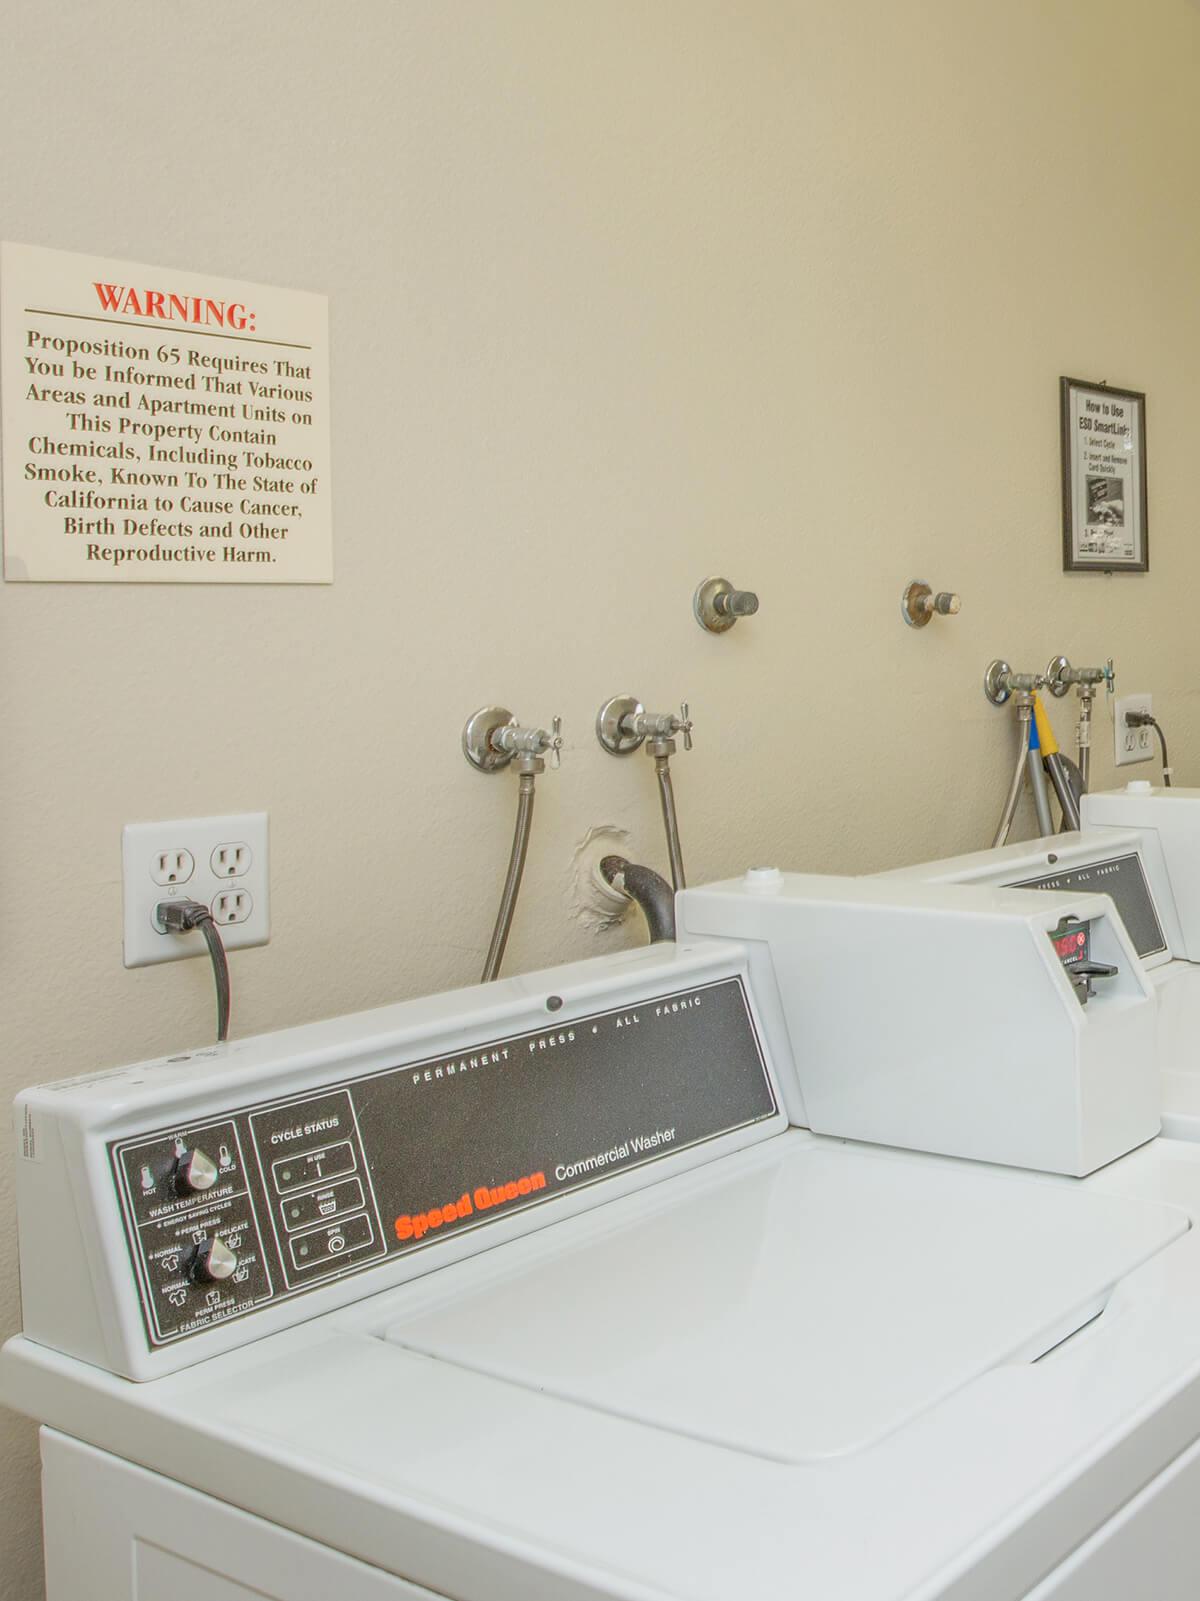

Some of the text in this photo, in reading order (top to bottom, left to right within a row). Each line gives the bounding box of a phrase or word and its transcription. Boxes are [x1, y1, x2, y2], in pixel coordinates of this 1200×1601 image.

[92, 282, 256, 331] WARNING:
[26, 330, 311, 379] Proposition 65 Requires That
[24, 357, 312, 402] You be Informed That Various
[25, 384, 312, 424] Areas and Apartment Units on
[1111, 404, 1124, 418] Use
[66, 413, 277, 445] This Property Contain
[28, 437, 312, 471] Chemicals, Including Tobacco
[24, 463, 318, 494] Smoke, Known To The State of
[44, 490, 302, 517] California to Cause Cancer,
[64, 517, 288, 539] Birth Defects and Other
[86, 543, 276, 565] Reproductive Harm.
[413, 998, 702, 1084] PERMANENT PRESS ALL FABRIC
[271, 1118, 339, 1144] CYCLE STATUS
[219, 1165, 236, 1173] COLD
[143, 1188, 156, 1196] HOT
[395, 1127, 676, 1240] Speed Queen Commercial Washer
[149, 1187, 233, 1217] WASH TEMPERATURE
[164, 1215, 187, 1226] ENERGY
[210, 1202, 232, 1212] CYCLES
[180, 1218, 221, 1234] PERM PRESS
[220, 1222, 248, 1236] DELICATE
[154, 1246, 183, 1258] NORMAL
[162, 1281, 190, 1293] NORMAL
[180, 1300, 254, 1332] FABRIC SELECTOR
[195, 1298, 235, 1317] PERM PRESS
